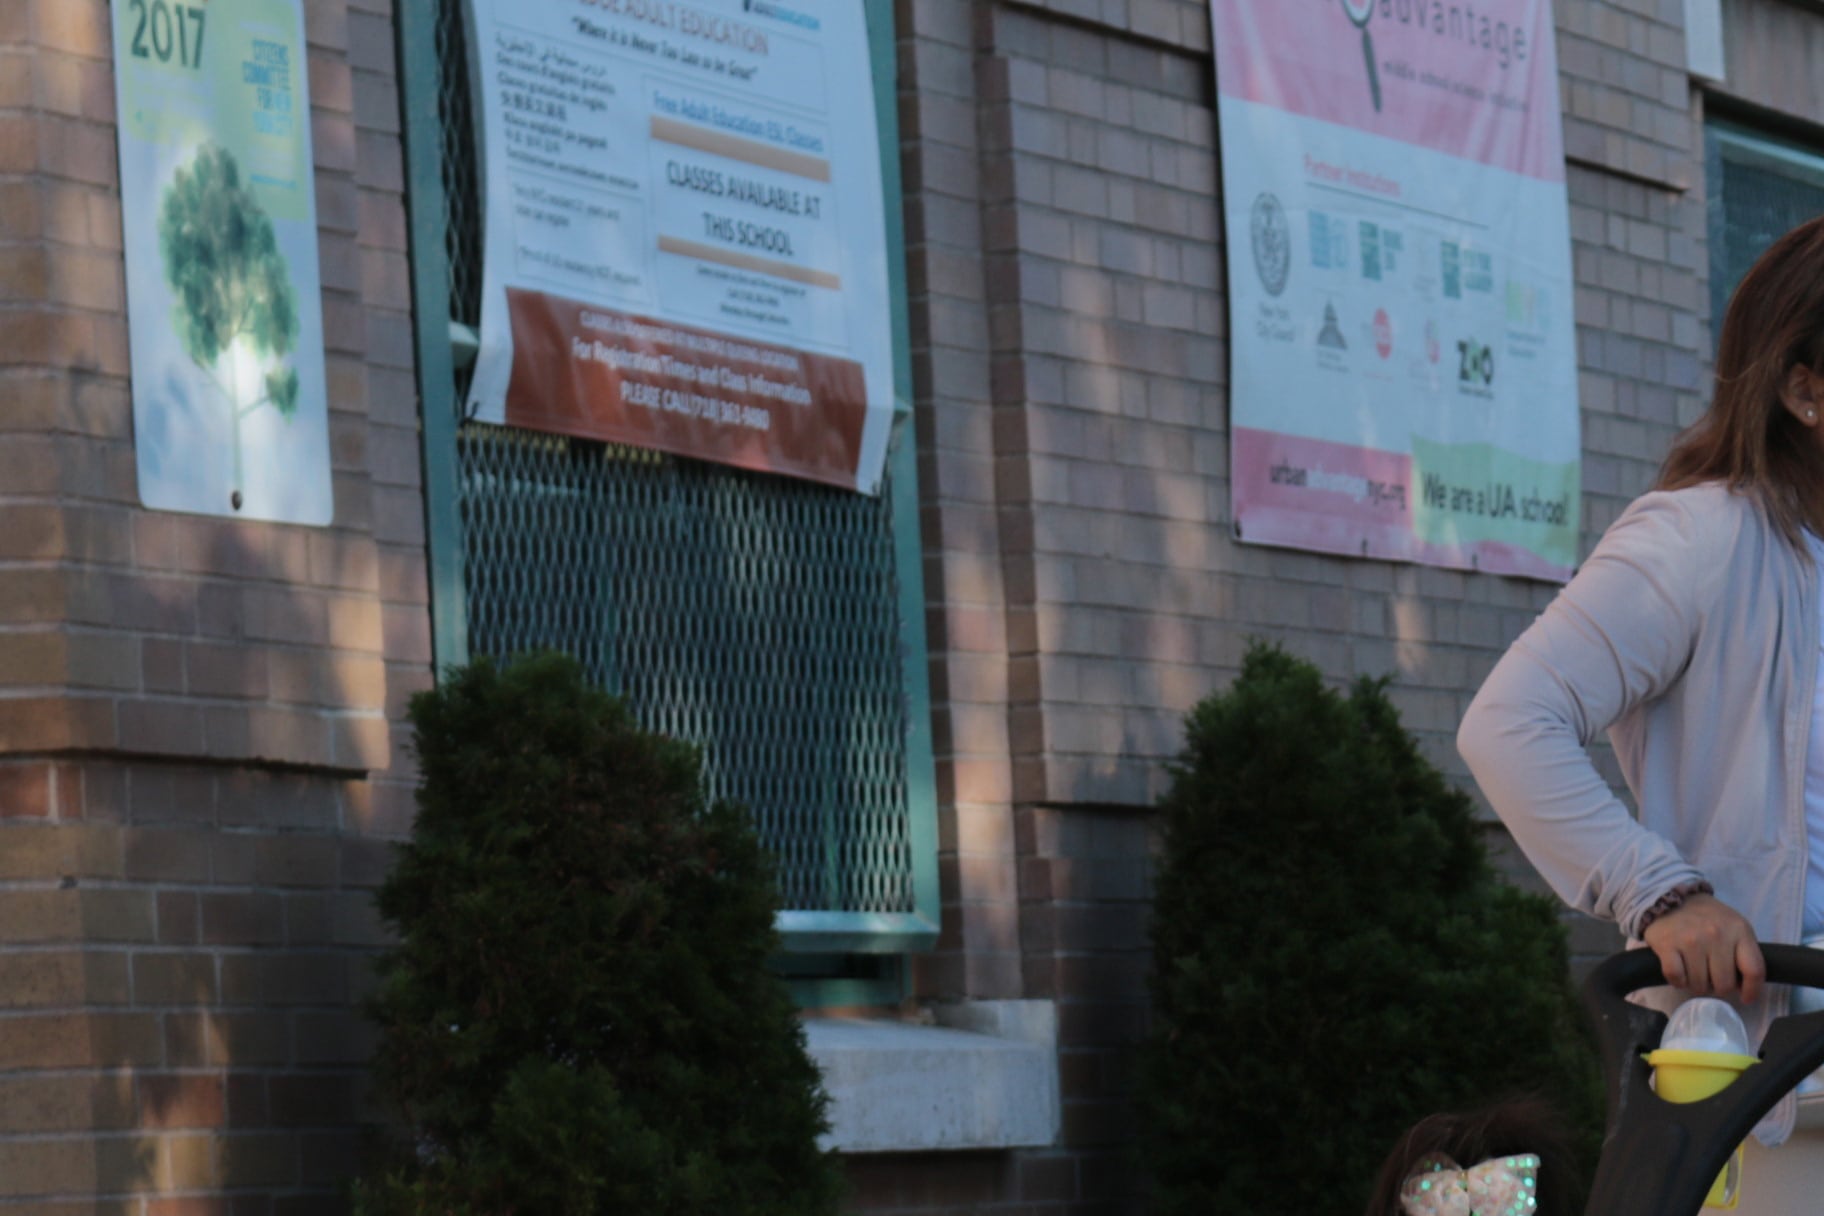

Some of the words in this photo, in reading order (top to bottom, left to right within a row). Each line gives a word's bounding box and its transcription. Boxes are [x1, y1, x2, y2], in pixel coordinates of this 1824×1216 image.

[129, 0, 206, 69] 2017
[680, 9, 769, 55] EDUCATION
[654, 89, 679, 114] Free
[681, 98, 710, 122] Adult
[712, 106, 764, 136] Education
[786, 125, 824, 153] Classes
[666, 159, 725, 198] CLASSES
[727, 176, 801, 216] AVAILABLE
[804, 195, 821, 220] AT
[702, 211, 736, 243] THIS
[737, 220, 795, 257] SCHOOL
[571, 336, 592, 361] For
[593, 340, 661, 375] Registration
[661, 354, 697, 381] Times
[698, 364, 719, 386] and
[720, 366, 747, 392] Class
[749, 372, 812, 406] Information
[620, 380, 661, 409] PLEASE
[662, 389, 690, 415] CALL
[1423, 472, 1447, 510] We
[1451, 486, 1473, 515] are
[1477, 489, 1485, 516] a
[1487, 481, 1518, 519] UA
